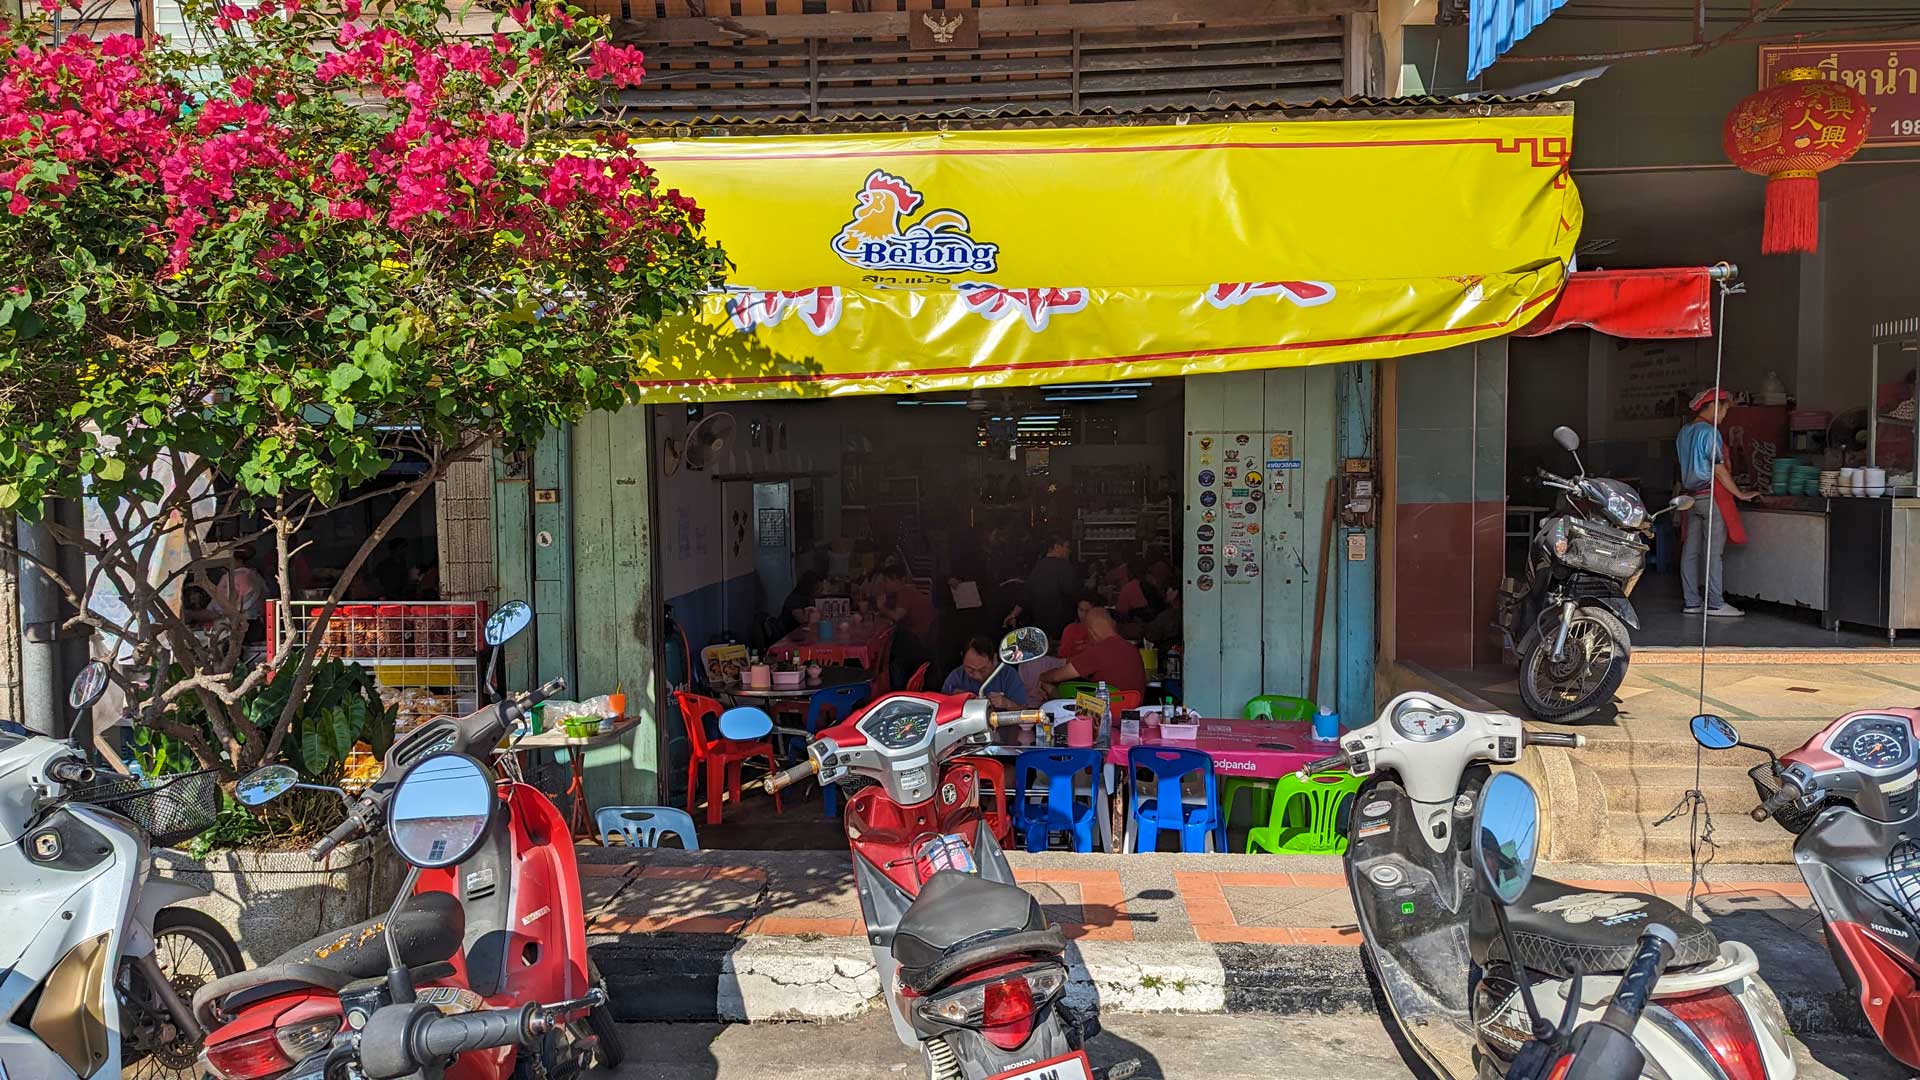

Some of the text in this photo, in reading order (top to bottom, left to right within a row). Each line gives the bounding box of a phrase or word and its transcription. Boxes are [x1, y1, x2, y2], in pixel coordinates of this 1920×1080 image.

[1213, 758, 1256, 771] odpanda
[1870, 922, 1909, 938] HONDA
[1003, 1058, 1036, 1071] HONDA
